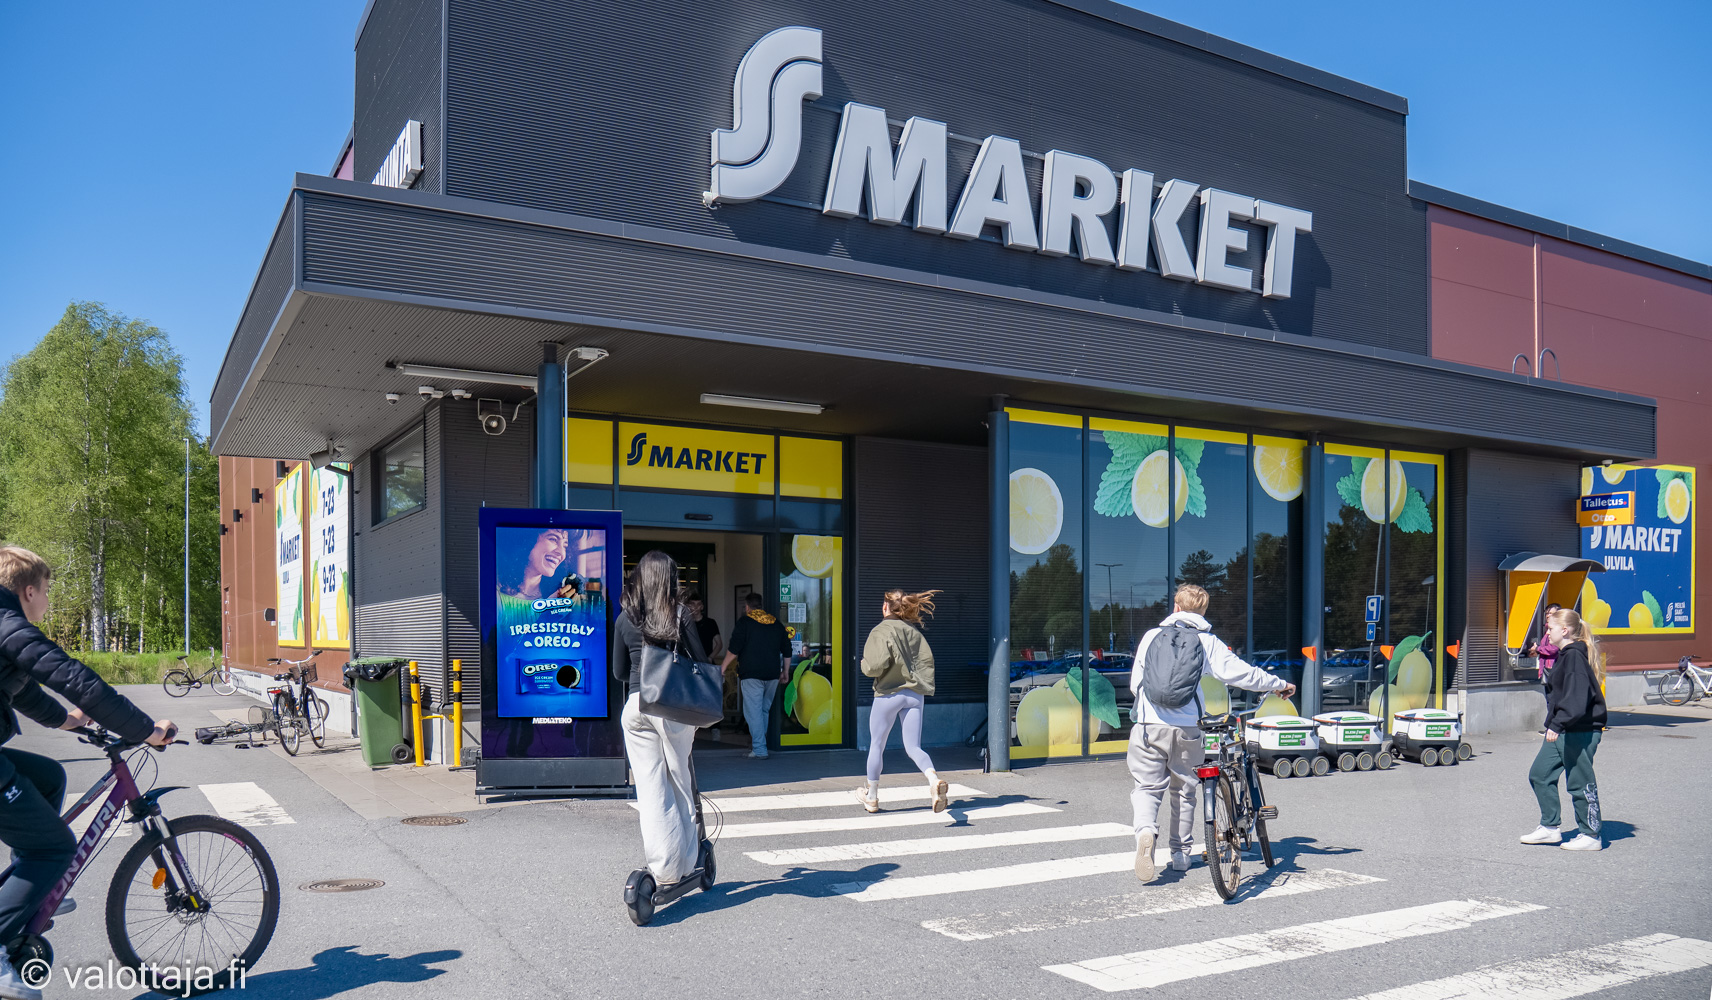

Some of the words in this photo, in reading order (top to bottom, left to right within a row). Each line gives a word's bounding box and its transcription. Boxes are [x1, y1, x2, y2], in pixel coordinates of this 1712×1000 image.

[711, 26, 822, 201] S
[822, 101, 1312, 299] MARKET
[627, 433, 647, 466] S
[648, 445, 767, 475] MARKET
[283, 534, 300, 565] MARKET
[1604, 525, 1682, 553] MARKET
[1604, 555, 1635, 571] ULVILA
[322, 563, 336, 593] 9-23
[533, 599, 573, 611] OREO
[509, 622, 595, 637] IRRESISTIBLY
[534, 636, 571, 648] OREO
[523, 663, 558, 675] OREO
